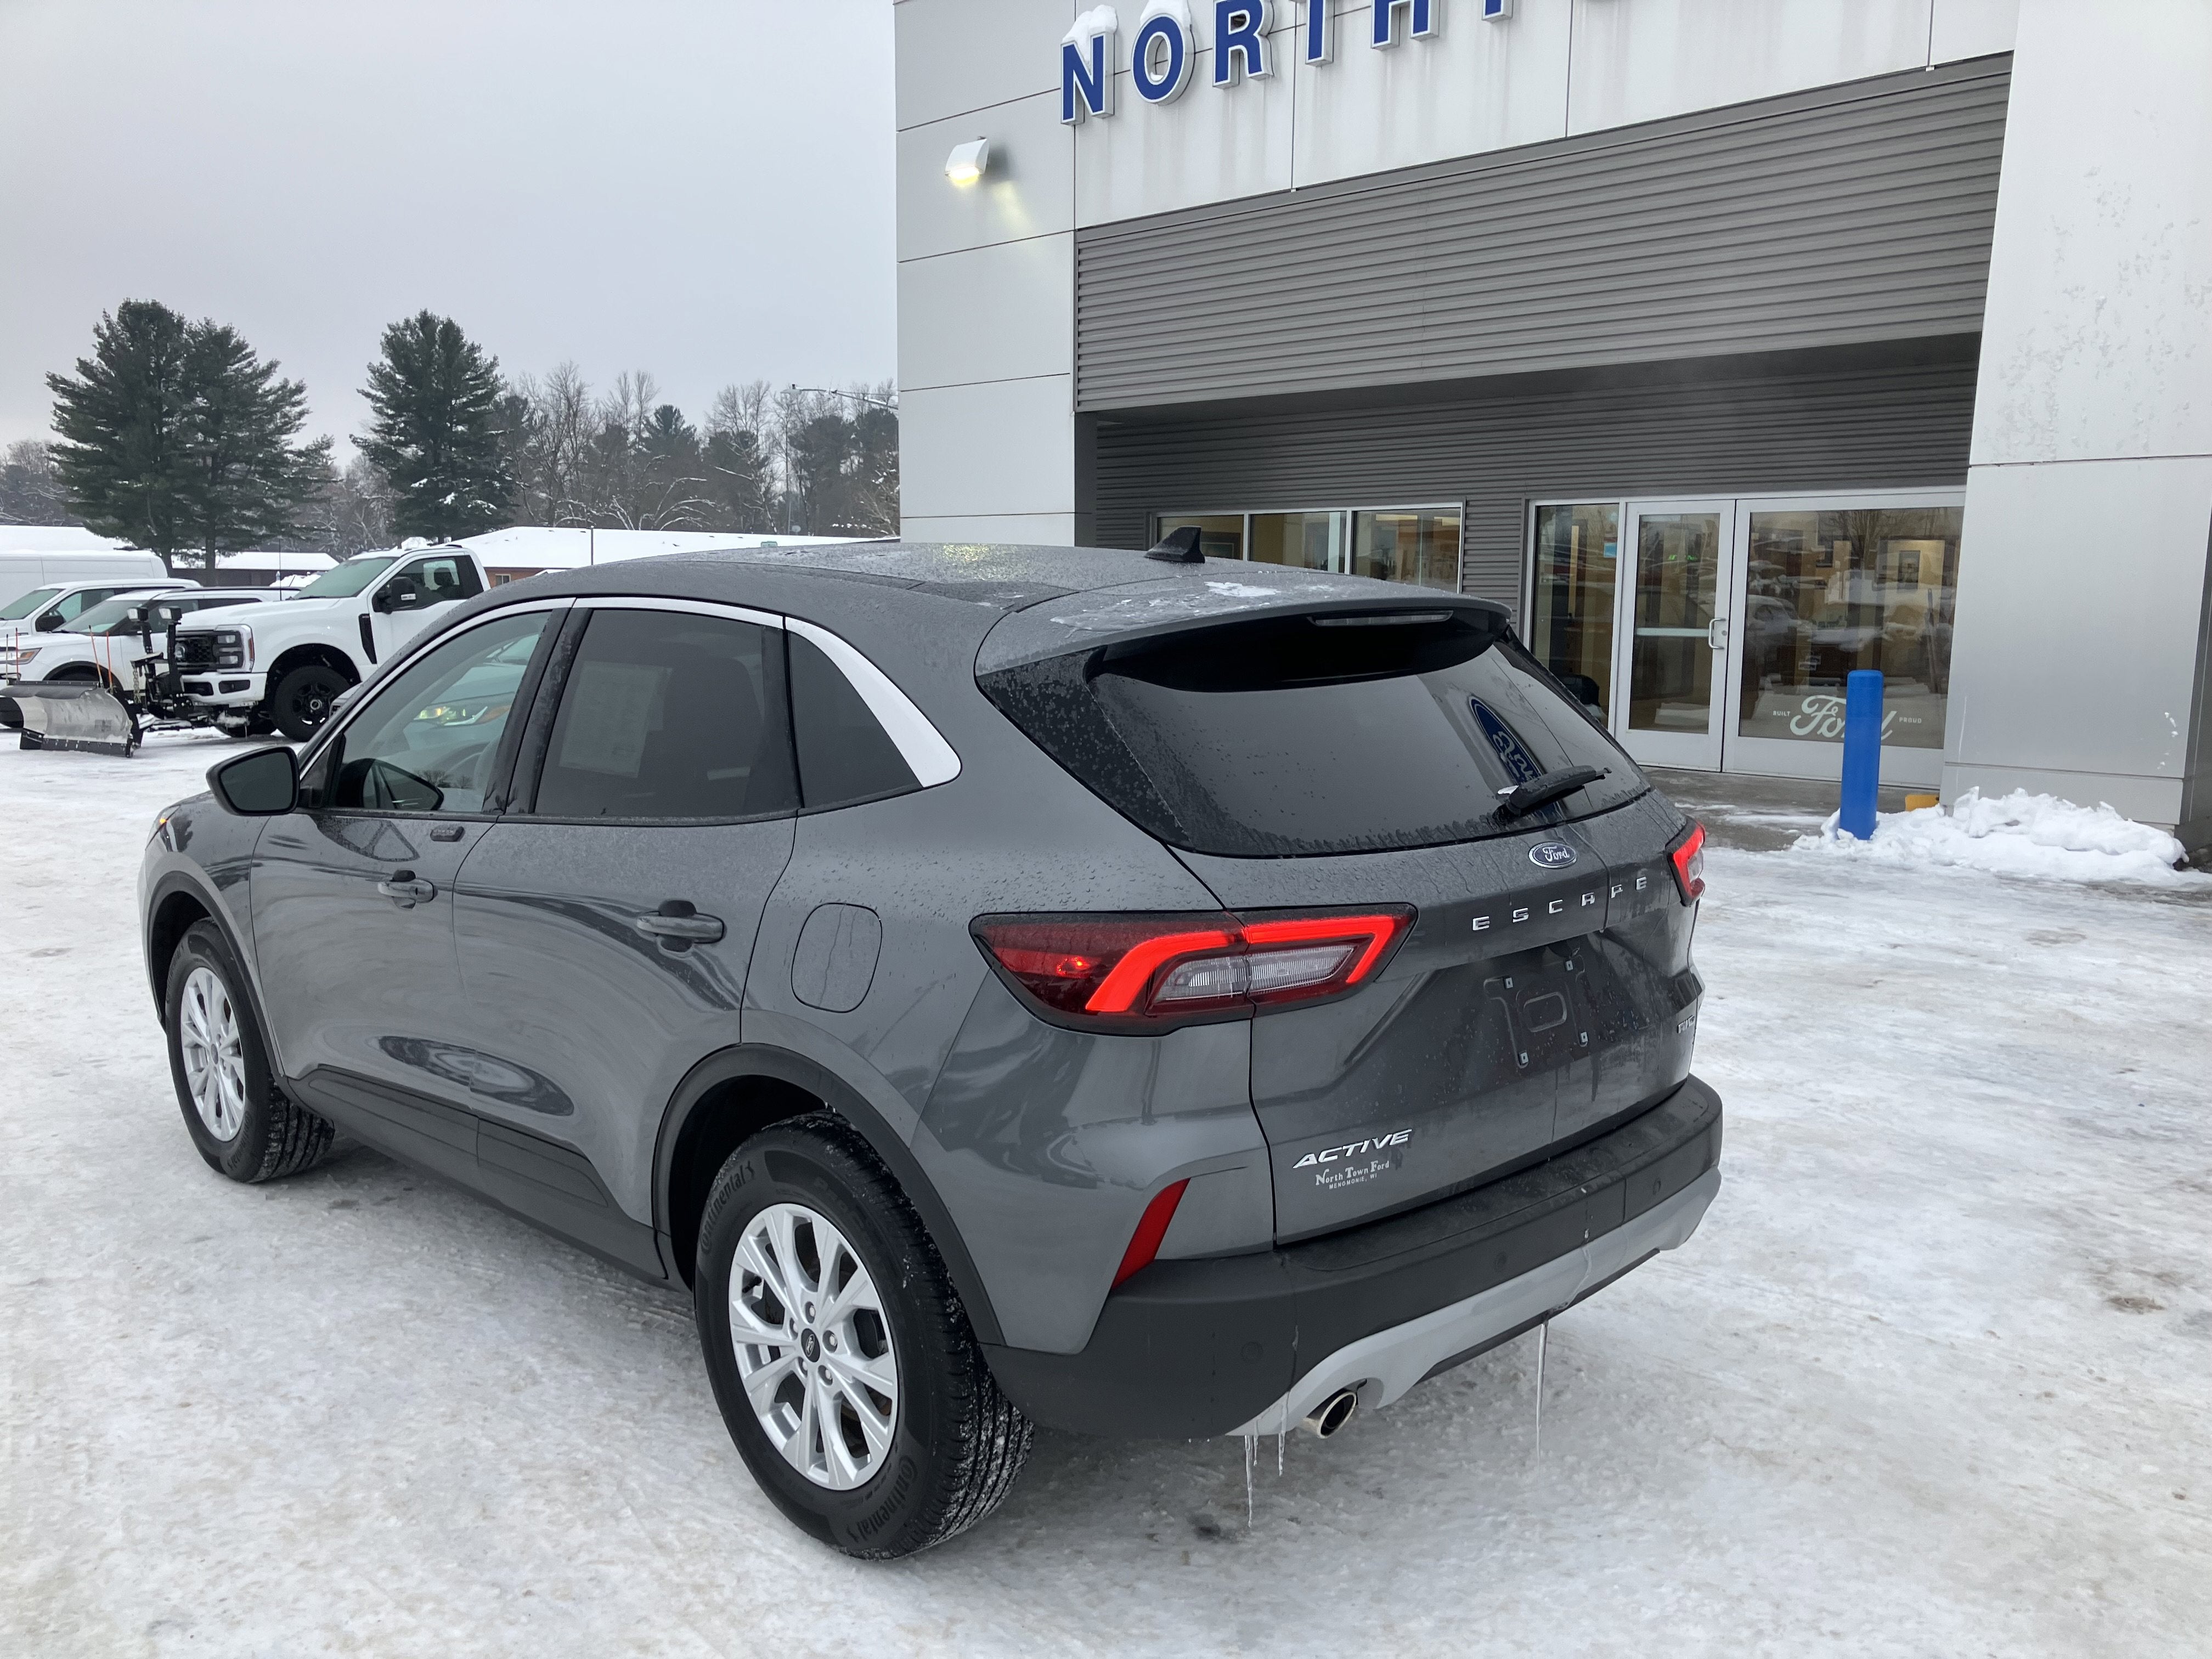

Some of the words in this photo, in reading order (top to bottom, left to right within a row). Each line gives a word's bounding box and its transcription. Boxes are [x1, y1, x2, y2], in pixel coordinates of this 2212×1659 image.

[1542, 845, 1570, 862] Ford
[1472, 876, 1647, 931] ESCAPE
[1293, 1128, 1412, 1169] ACTIVE
[1316, 1168, 1344, 1186] North
[1345, 1166, 1369, 1178] Town
[1370, 1160, 1390, 1172] Ford
[701, 1164, 747, 1255] Continental
